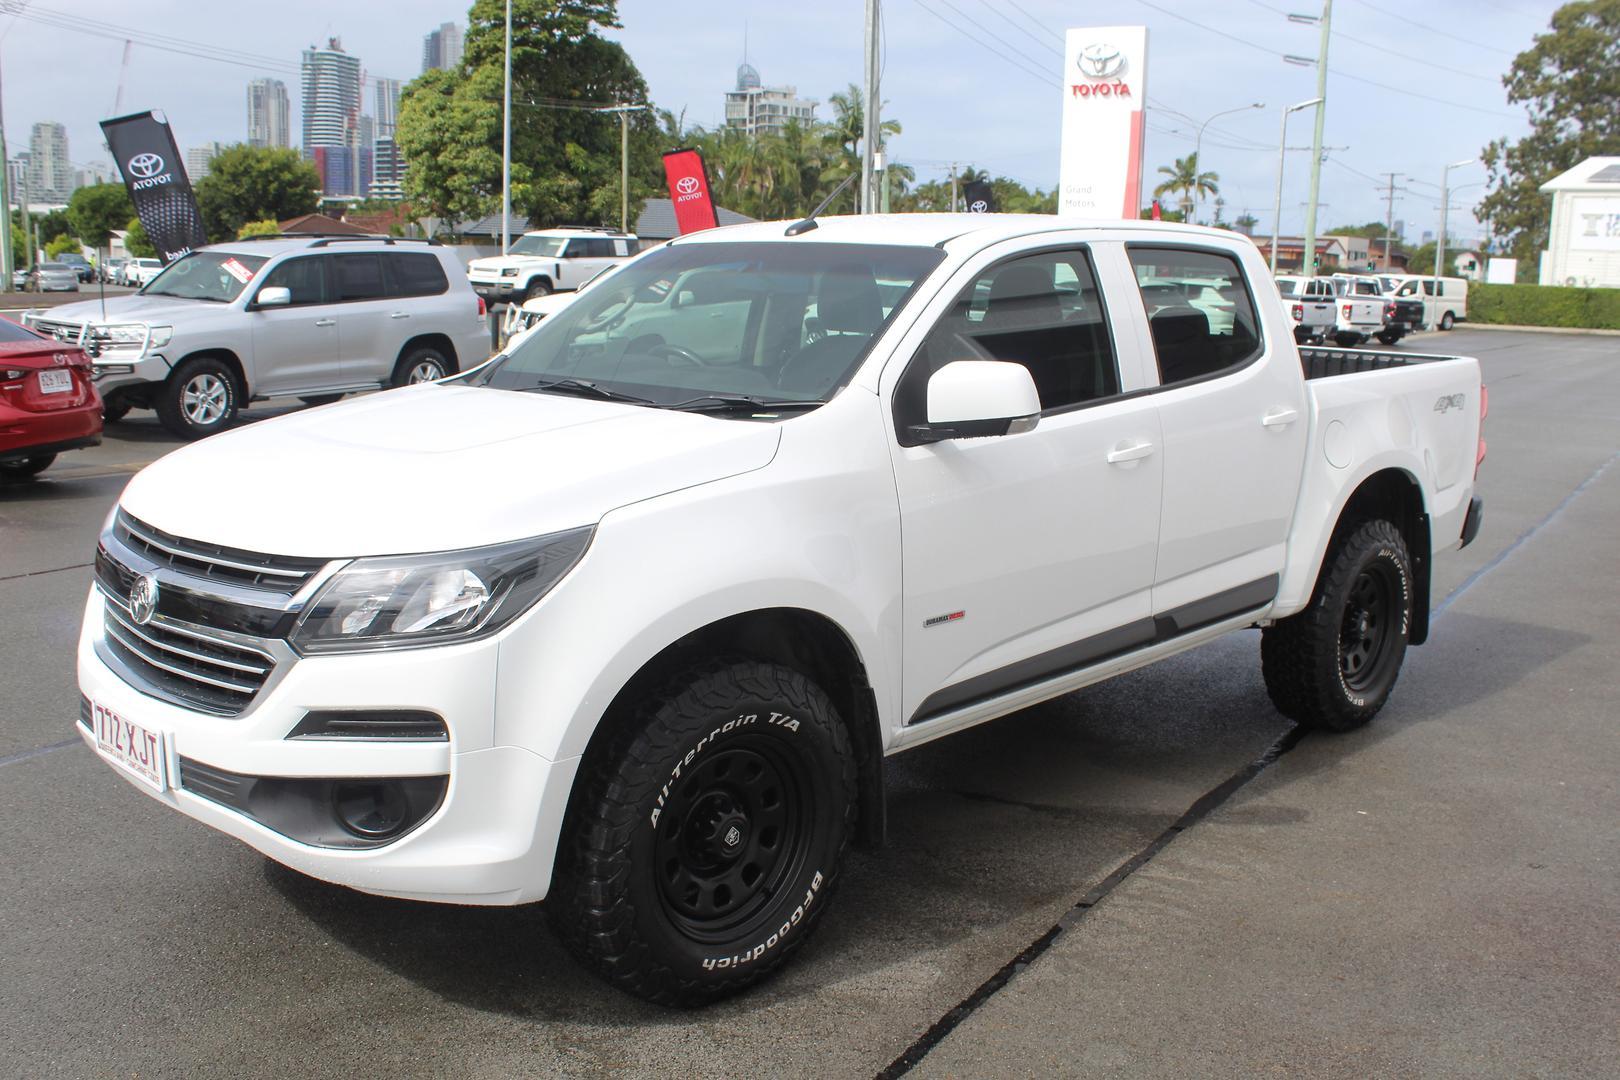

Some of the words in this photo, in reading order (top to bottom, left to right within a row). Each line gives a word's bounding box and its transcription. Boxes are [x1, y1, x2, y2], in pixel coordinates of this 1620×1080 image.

[1071, 83, 1131, 97] TOYOTA
[1065, 199, 1096, 208] Motors
[1066, 184, 1092, 194] Grand
[96, 705, 122, 750] 772
[125, 721, 156, 772] XJT
[650, 714, 758, 829] All-Terrain
[768, 712, 801, 733] T/A
[702, 870, 823, 971] BFGoodrich
